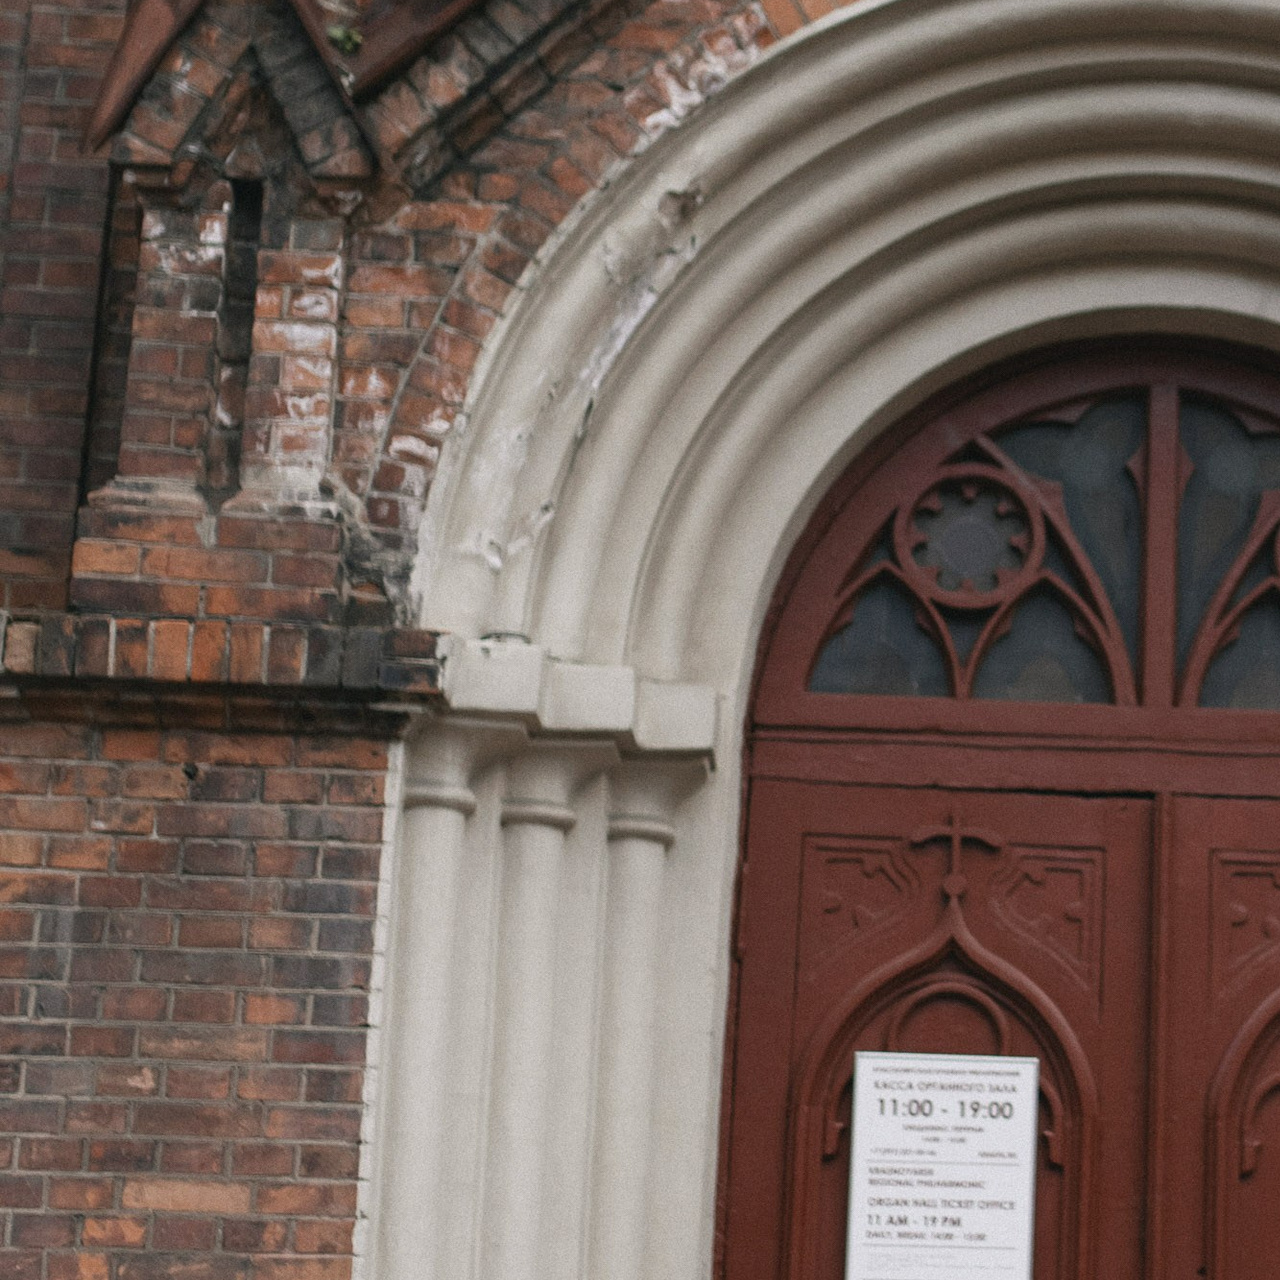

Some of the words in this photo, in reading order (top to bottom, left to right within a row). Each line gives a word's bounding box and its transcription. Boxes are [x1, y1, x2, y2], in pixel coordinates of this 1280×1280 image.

[878, 1097, 933, 1117] 11:00
[959, 1100, 1014, 1119] 19:00
[867, 1196, 909, 1207] ORGAN
[941, 1199, 974, 1209] TICKET
[978, 1199, 1016, 1210] OFFICE
[867, 1214, 881, 1225] 11
[886, 1215, 908, 1226] AM
[941, 1215, 962, 1227] PM
